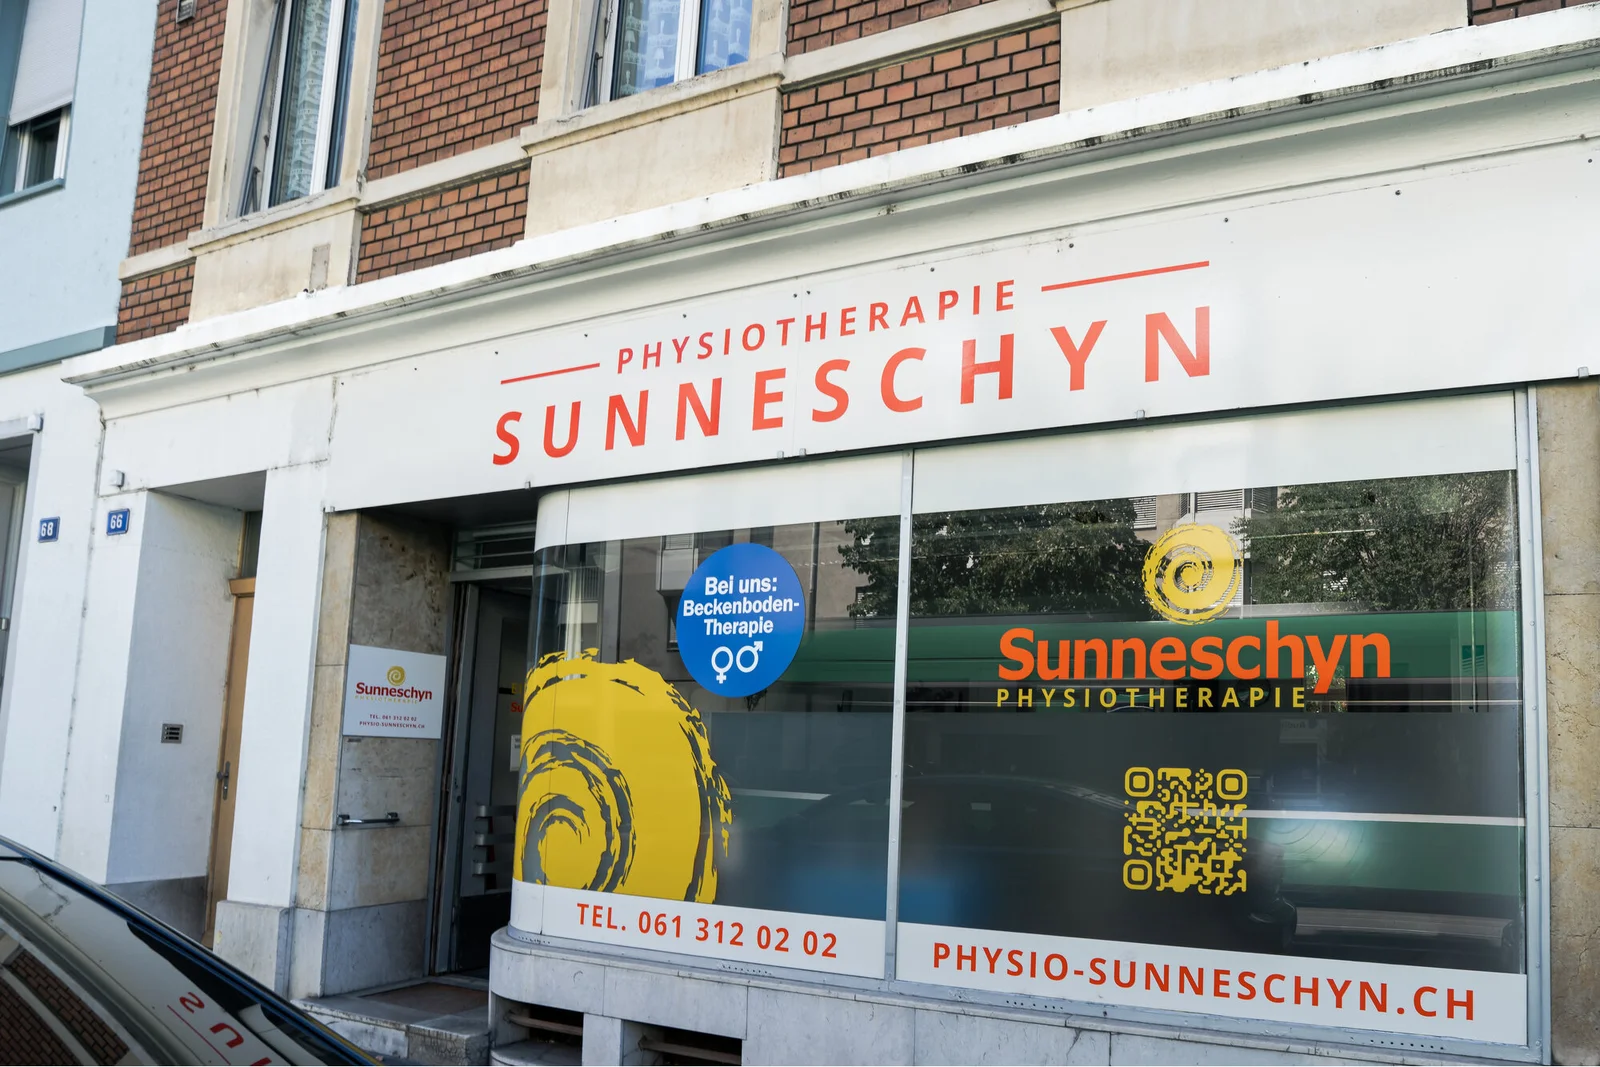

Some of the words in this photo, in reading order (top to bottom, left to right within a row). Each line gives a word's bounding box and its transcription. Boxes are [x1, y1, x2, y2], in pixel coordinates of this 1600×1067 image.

[617, 279, 1015, 374] PHYSIOTHERAPIE
[492, 305, 1210, 466] SUNNESCHYN
[41, 521, 54, 537] 68
[110, 514, 123, 530] 66
[704, 575, 734, 596] Bei
[738, 577, 778, 594] uns:
[683, 595, 800, 617] Beckenboden-
[703, 616, 774, 638] Therapie
[997, 620, 1391, 695] Sunneschyn
[355, 682, 433, 702] Sunneschyn
[996, 686, 1305, 709] PHYSIOTHERAPIE
[576, 902, 627, 932] TEL.
[637, 911, 682, 938] 061
[695, 917, 744, 947] 312
[756, 925, 790, 953] 02
[802, 930, 838, 959] 02
[933, 942, 1475, 1021] PHYSIO-SUNNESCHYN.CH
